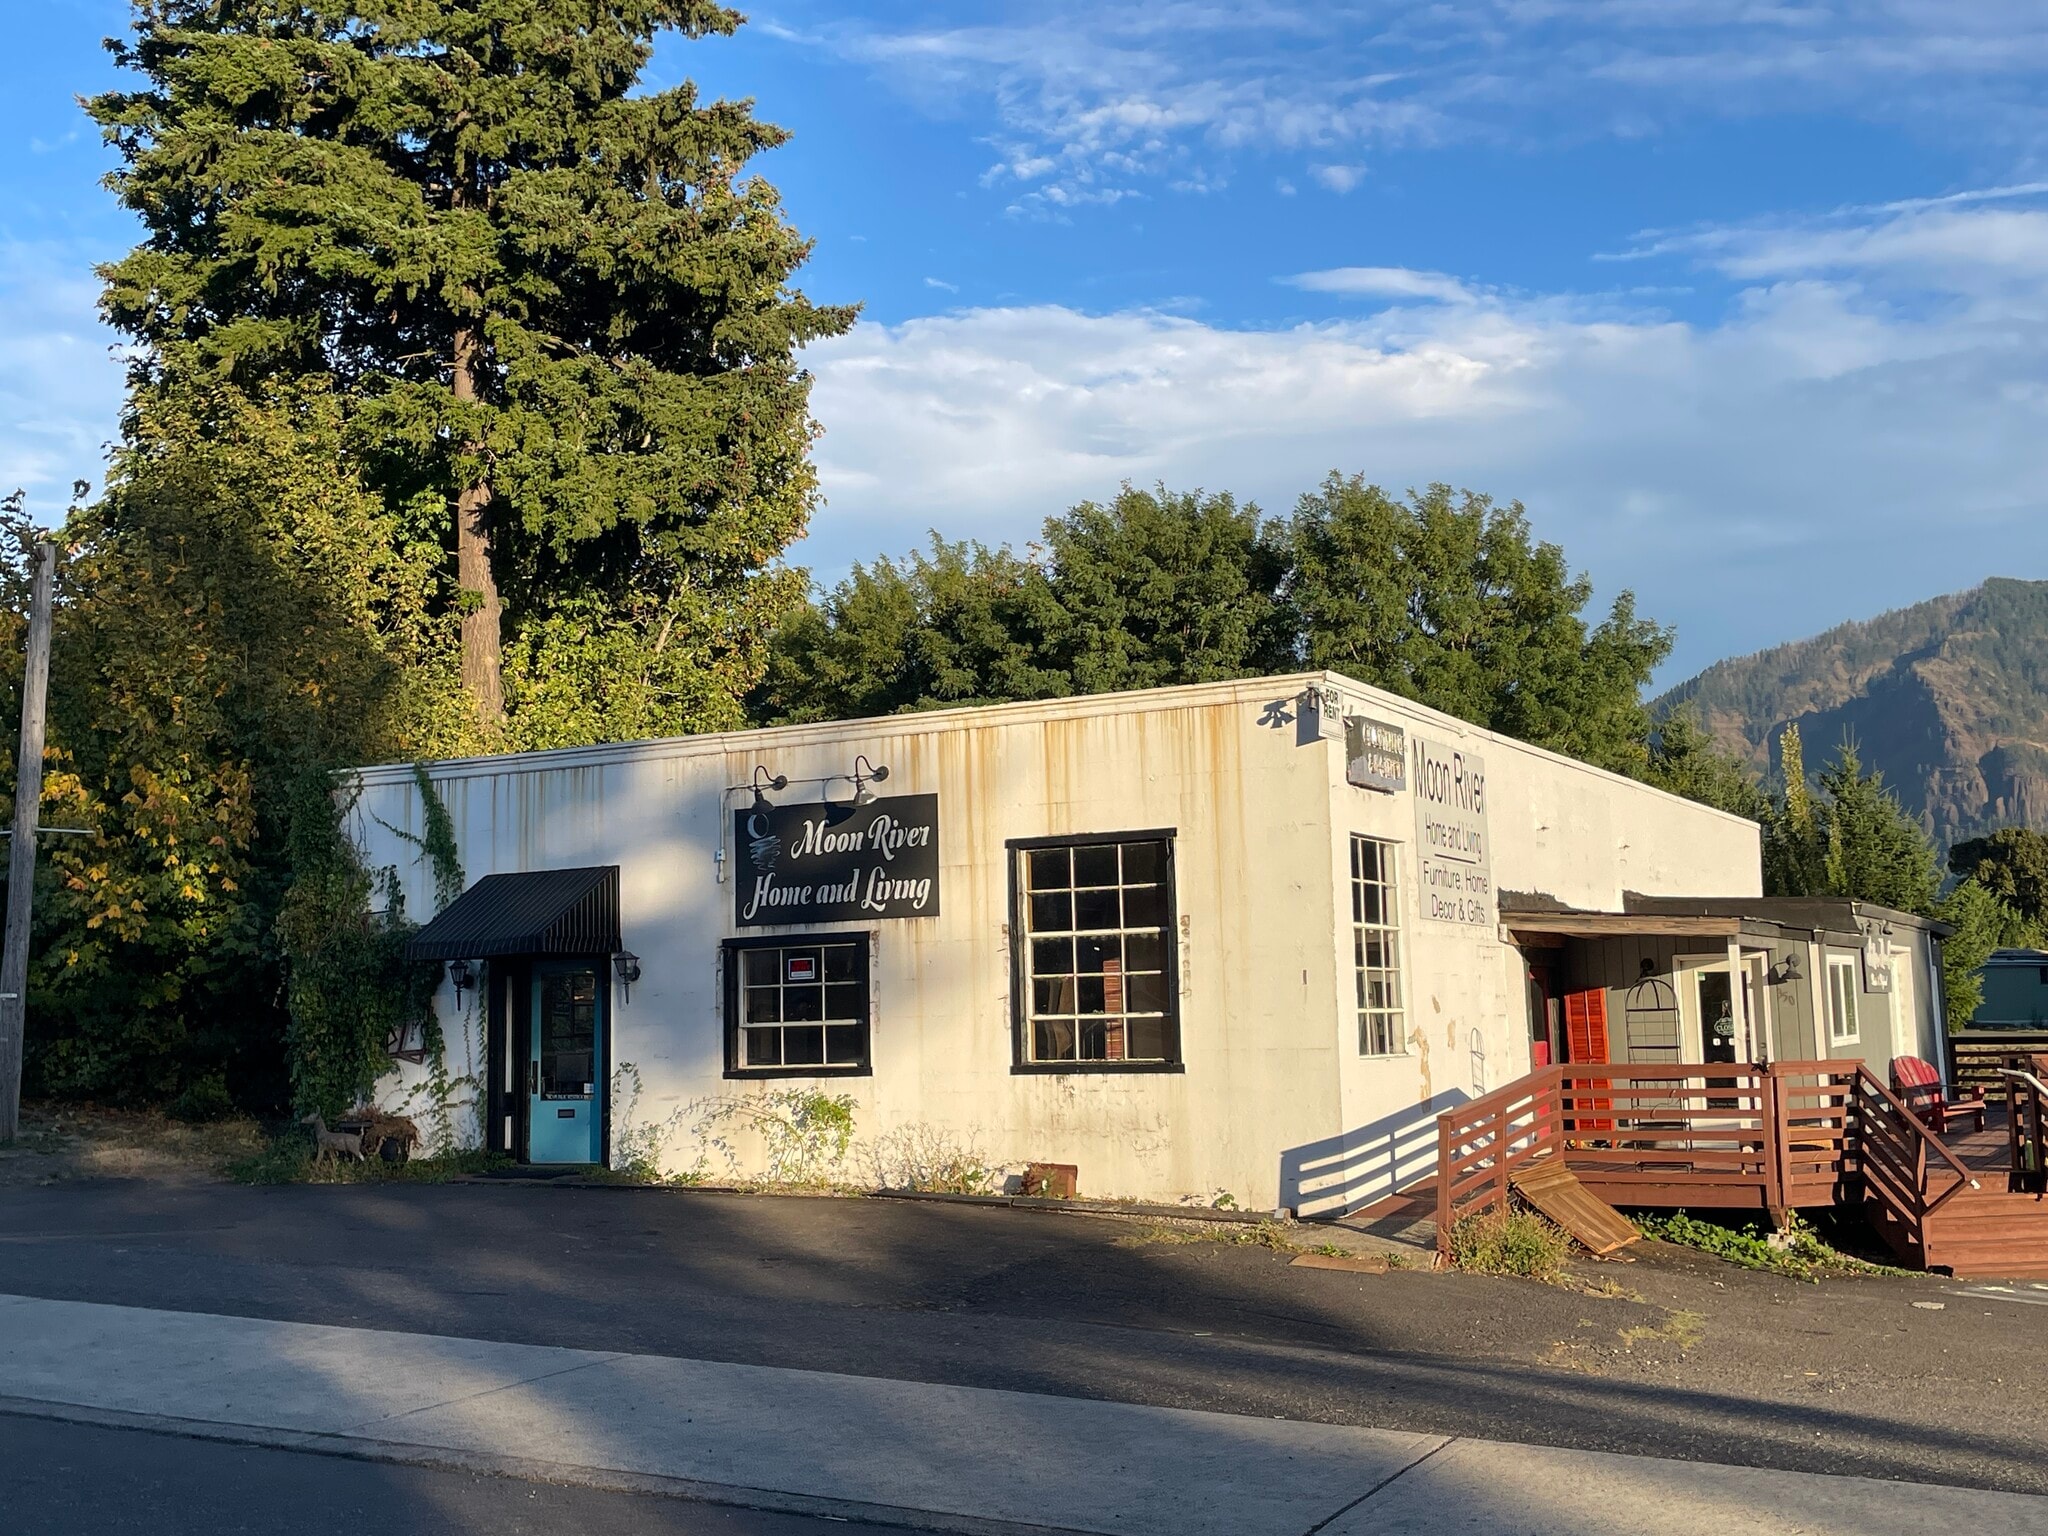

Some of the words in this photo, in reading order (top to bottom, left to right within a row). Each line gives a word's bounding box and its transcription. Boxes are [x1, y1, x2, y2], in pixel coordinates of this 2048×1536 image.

[1323, 704, 1340, 720] RENT
[1326, 688, 1338, 704] FOR
[1413, 739, 1451, 806] Moon
[1454, 752, 1484, 815] River
[791, 819, 864, 860] Moon
[868, 814, 930, 861] River
[1425, 812, 1447, 848] Home
[1448, 821, 1461, 850] and
[1462, 822, 1482, 862] Living
[743, 872, 812, 920] Home
[816, 868, 860, 904] and
[861, 866, 932, 912] Living
[1424, 861, 1463, 893] Furniture,
[1465, 868, 1488, 894] Home
[1432, 894, 1456, 919] Decor
[1459, 898, 1465, 921] &
[1467, 899, 1485, 924] Gifts
